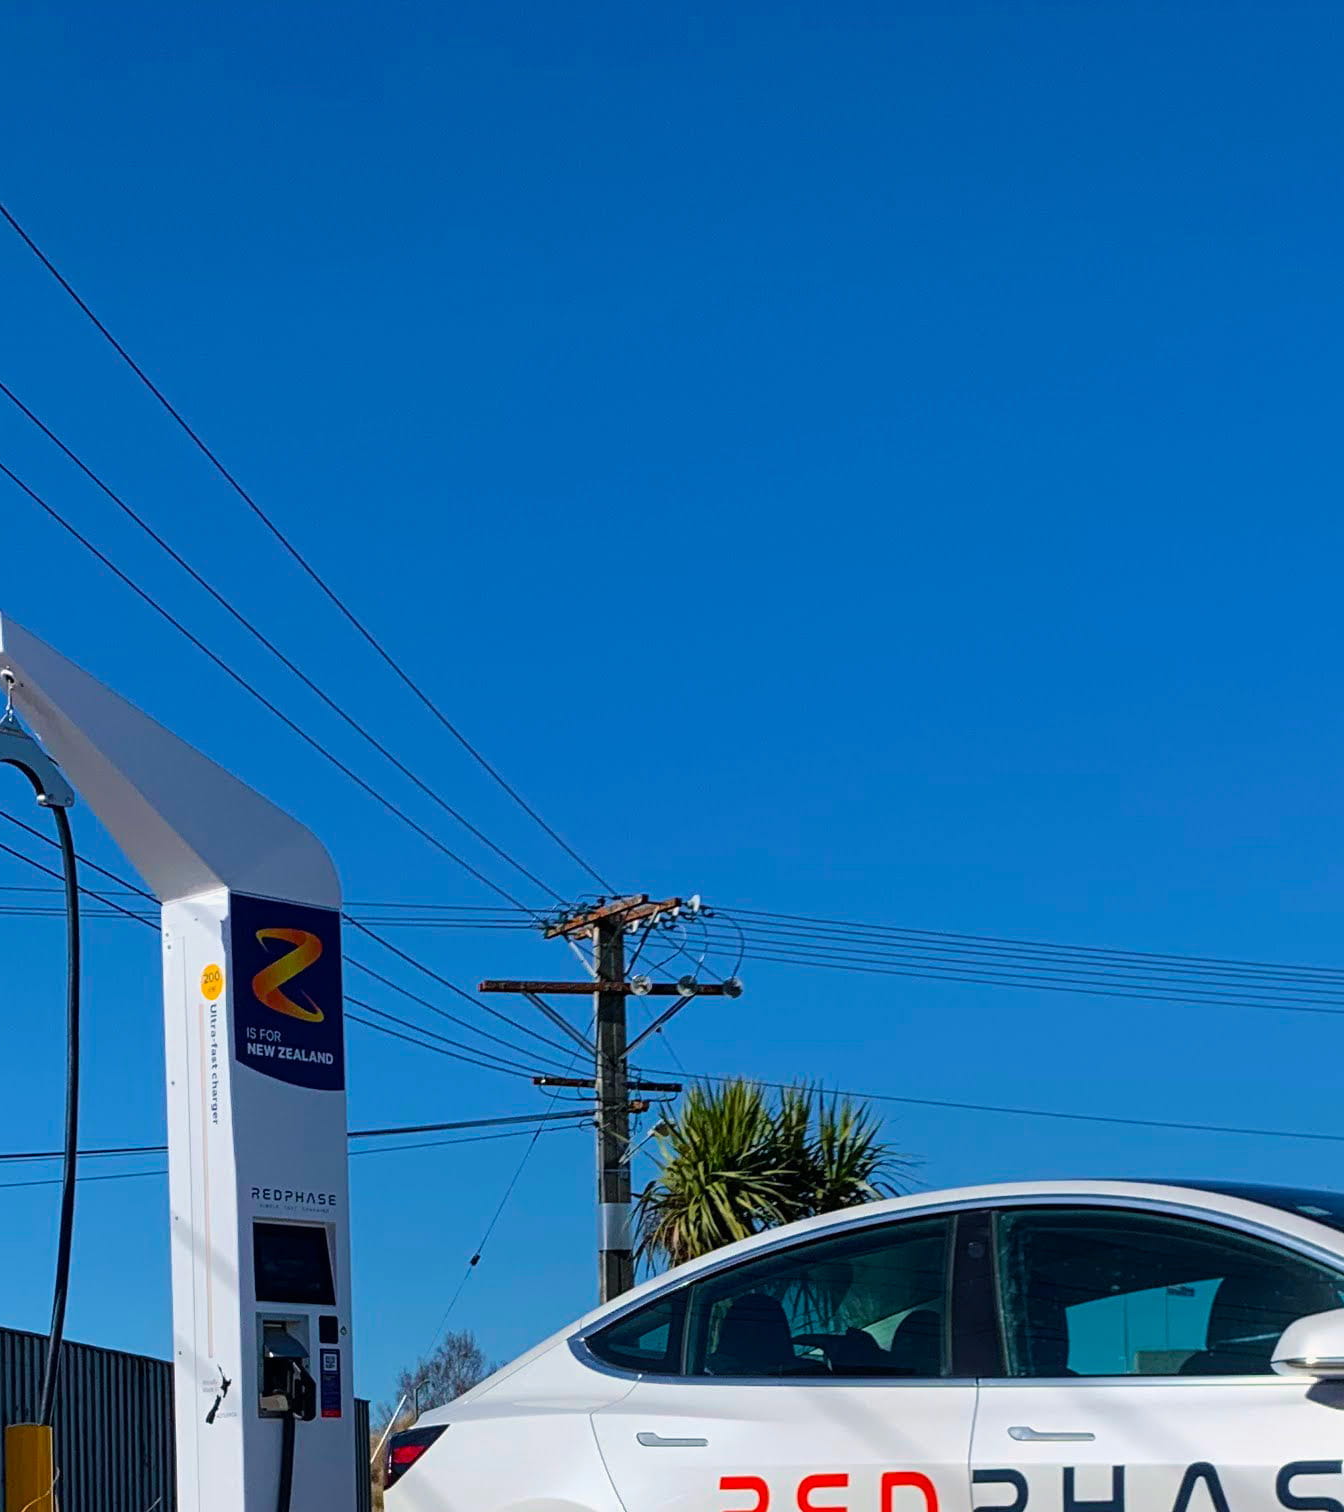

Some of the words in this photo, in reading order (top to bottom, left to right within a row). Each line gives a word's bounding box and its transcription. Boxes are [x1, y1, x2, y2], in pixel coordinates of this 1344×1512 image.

[203, 971, 220, 984] 200
[209, 1004, 219, 1069] Ultra-fast
[246, 1027, 257, 1040] IS
[260, 1029, 282, 1043] FOR
[247, 1043, 275, 1058] NEW
[278, 1046, 334, 1065] ZEALAND
[211, 1072, 219, 1125] charger
[251, 1187, 337, 1206] REDPHASE
